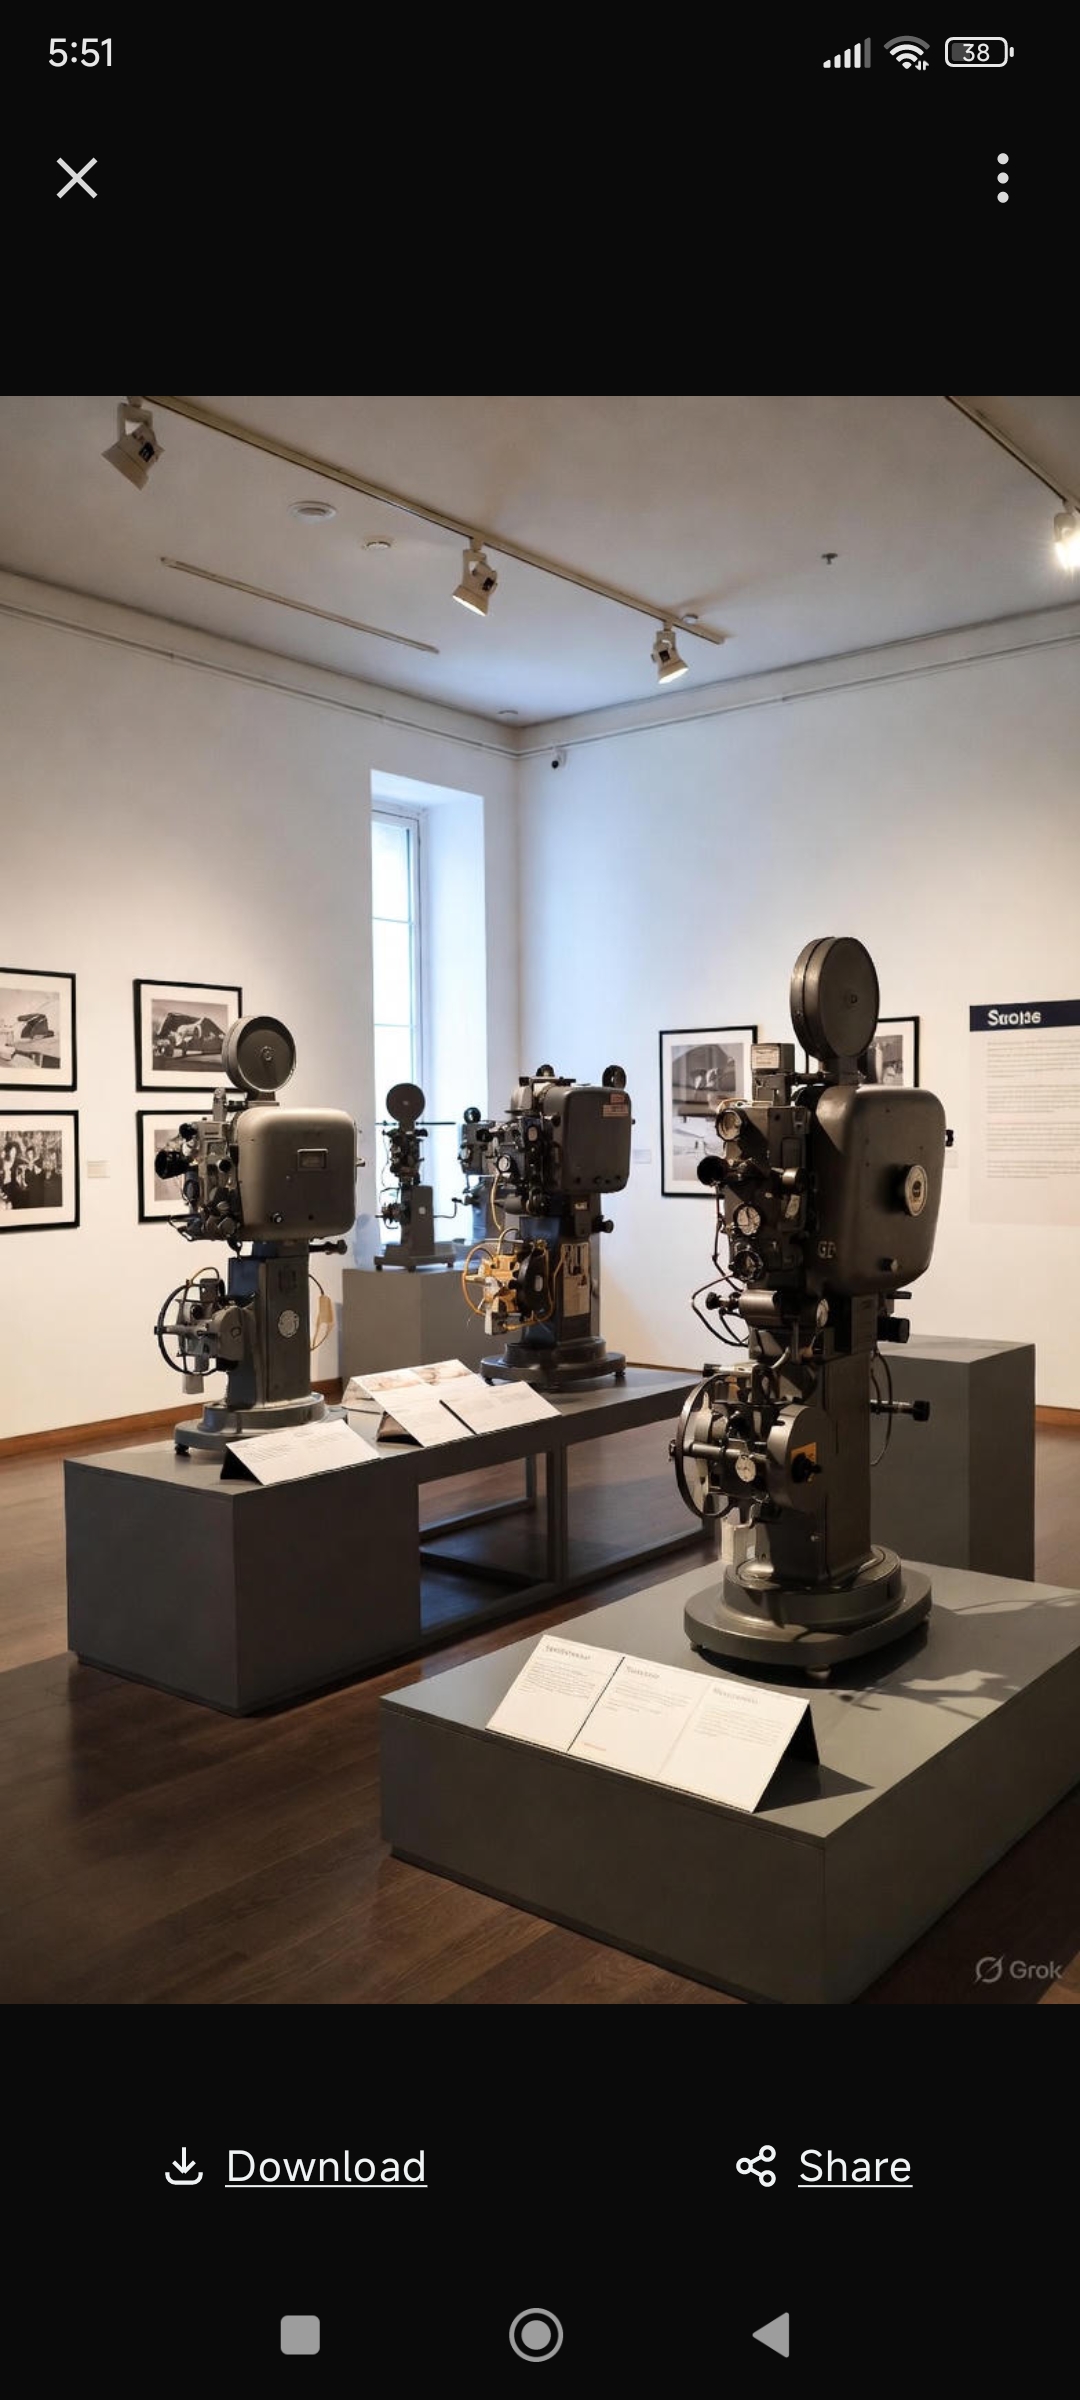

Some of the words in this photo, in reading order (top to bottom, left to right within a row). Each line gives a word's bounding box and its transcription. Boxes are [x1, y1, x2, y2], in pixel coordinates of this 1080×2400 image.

[48, 37, 113, 68] 5:51
[962, 43, 990, 62] 38
[226, 2149, 427, 2184] Download
[798, 2148, 912, 2184] Share
